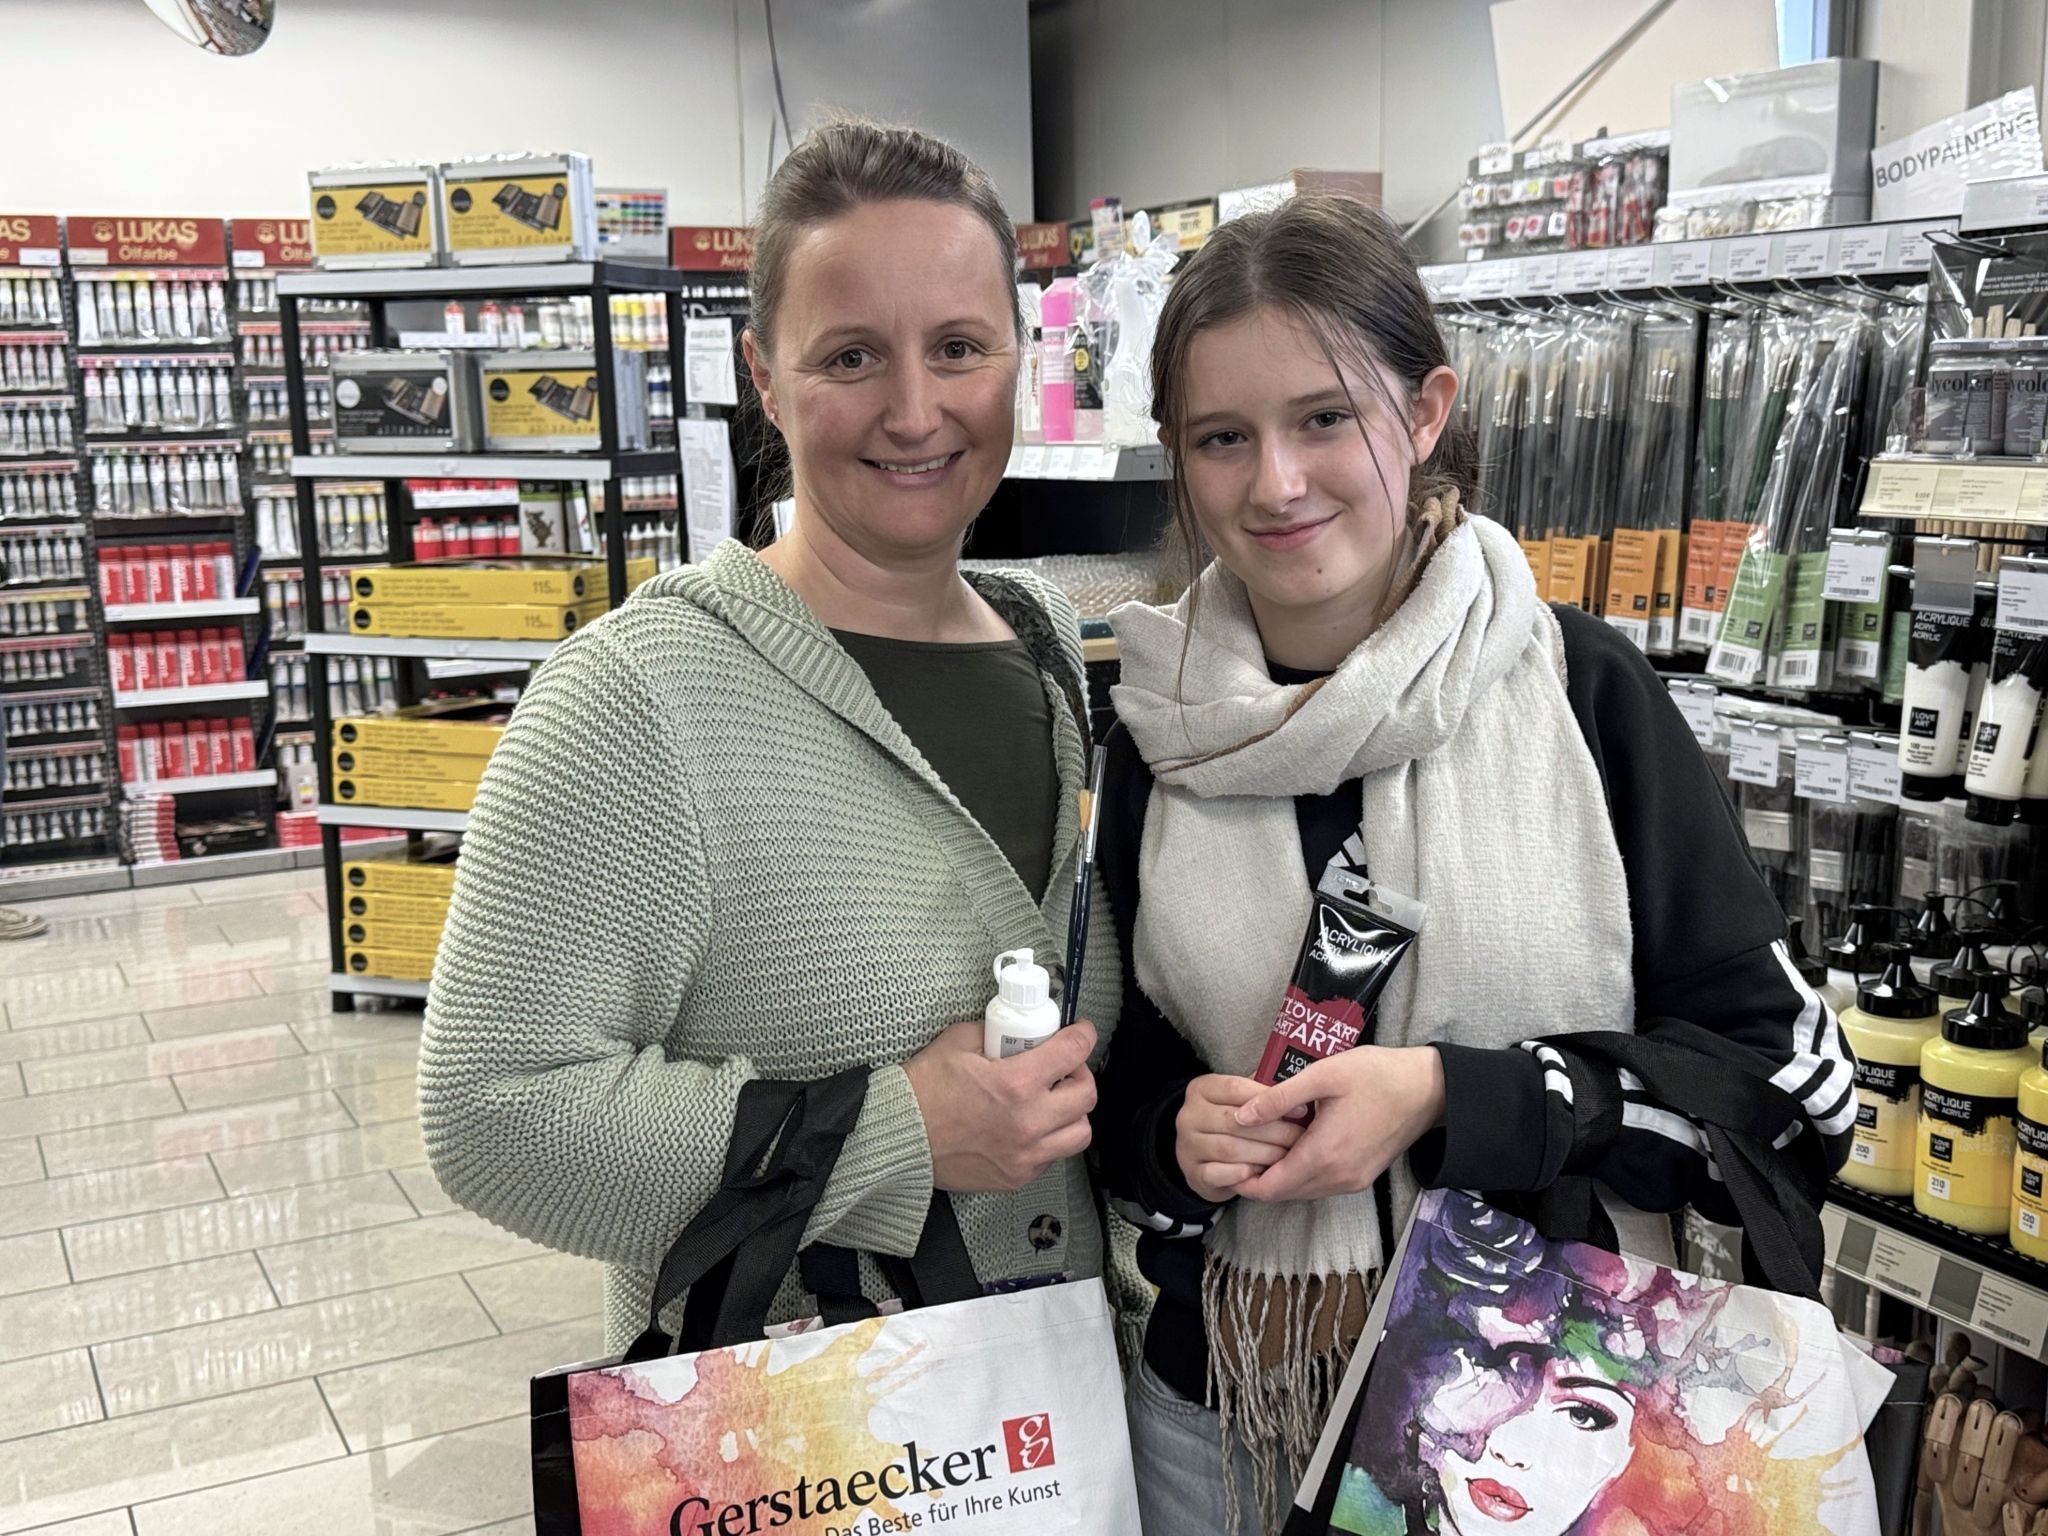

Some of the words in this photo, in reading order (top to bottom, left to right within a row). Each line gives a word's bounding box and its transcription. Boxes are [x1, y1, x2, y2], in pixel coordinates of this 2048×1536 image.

[116, 220, 199, 245] LUKAS
[118, 244, 178, 261] Ölfarbe
[532, 580, 551, 594] 115
[524, 615, 543, 628] 115
[1915, 611, 1971, 628] ACRYLIQUE
[1913, 622, 1937, 633] ACRYL
[1912, 631, 1942, 642] ACRYLIC
[1914, 719, 1931, 728] ART
[1915, 712, 1936, 722] LOVE
[1285, 999, 1328, 1029] LOVE
[1289, 1022, 1342, 1055] ART
[1328, 1021, 1360, 1043] ART
[1866, 1076, 1895, 1088] ACRYLIC
[1923, 1089, 1972, 1111] ACRYLIQUE
[1941, 1107, 1971, 1120] ACRYLIC
[1855, 1143, 1870, 1154] 200
[1931, 1176, 1945, 1189] 210
[2021, 1212, 2035, 1225] 220
[669, 1440, 997, 1536] Gerstaecker
[869, 1508, 923, 1536] Beste
[928, 1501, 957, 1525] für
[965, 1493, 1002, 1517] Ihre
[1009, 1479, 1061, 1508] Kunst
